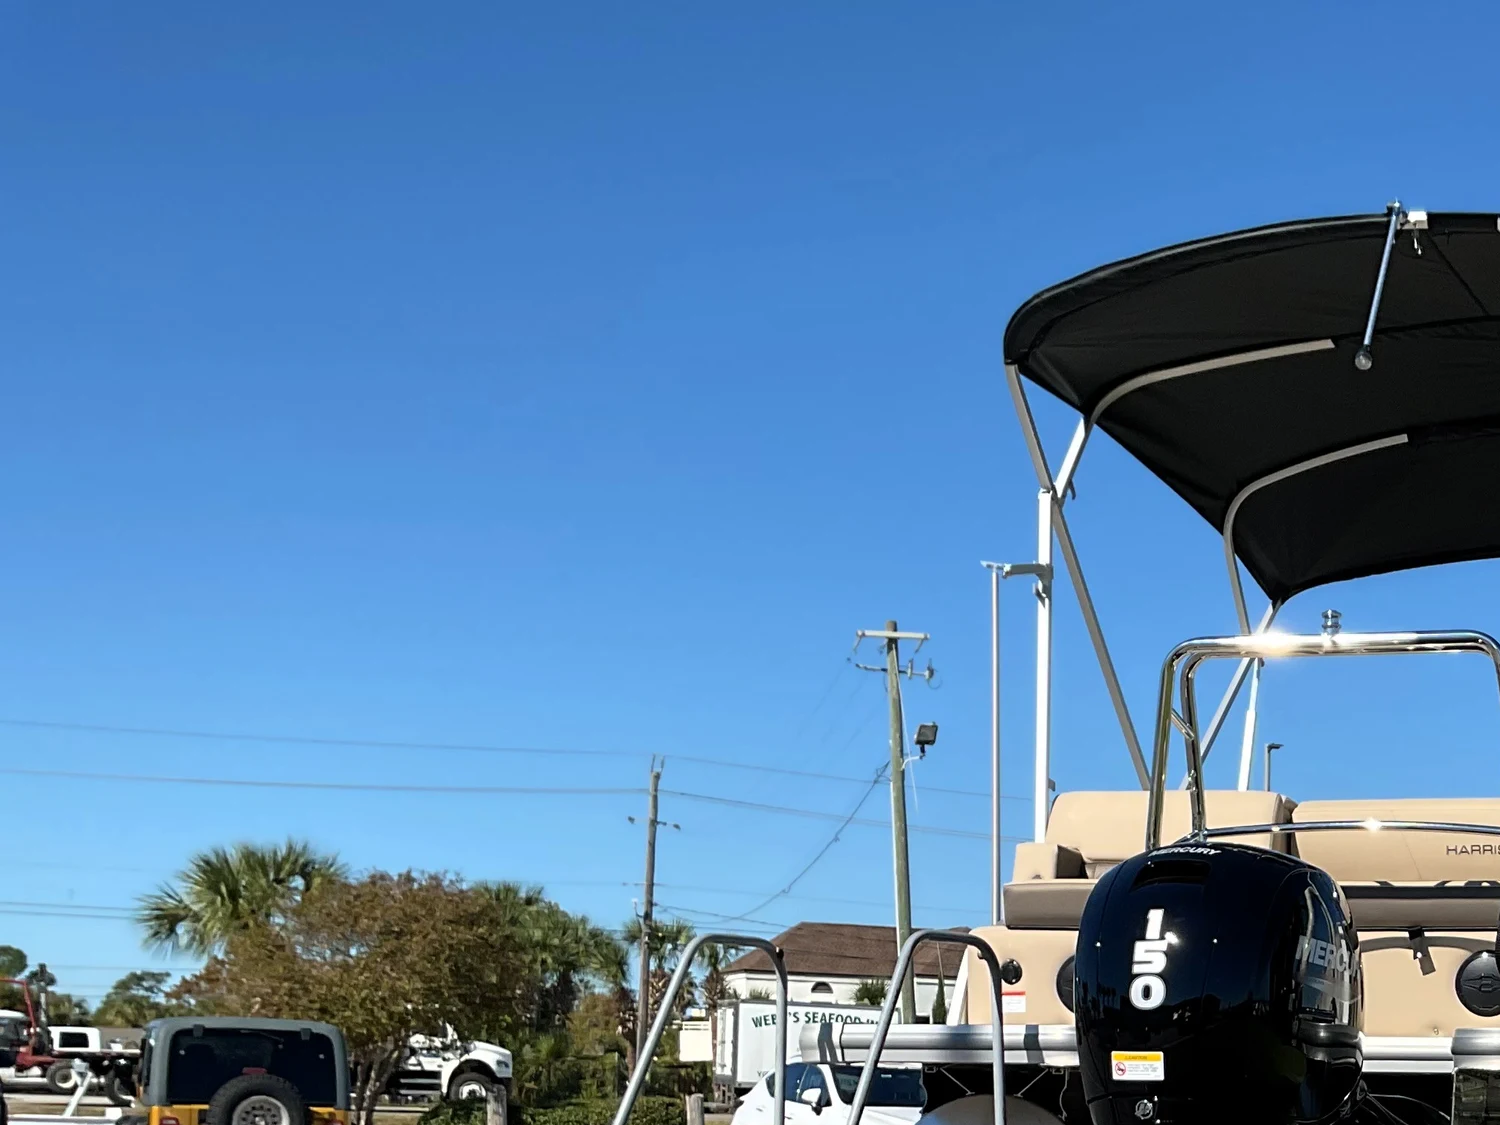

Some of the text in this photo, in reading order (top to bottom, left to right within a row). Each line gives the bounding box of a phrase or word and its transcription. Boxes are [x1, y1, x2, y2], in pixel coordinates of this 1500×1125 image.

[1148, 846, 1222, 857] MERCURY
[1128, 908, 1168, 1011] 150
[751, 1011, 800, 1028] WEB'S
